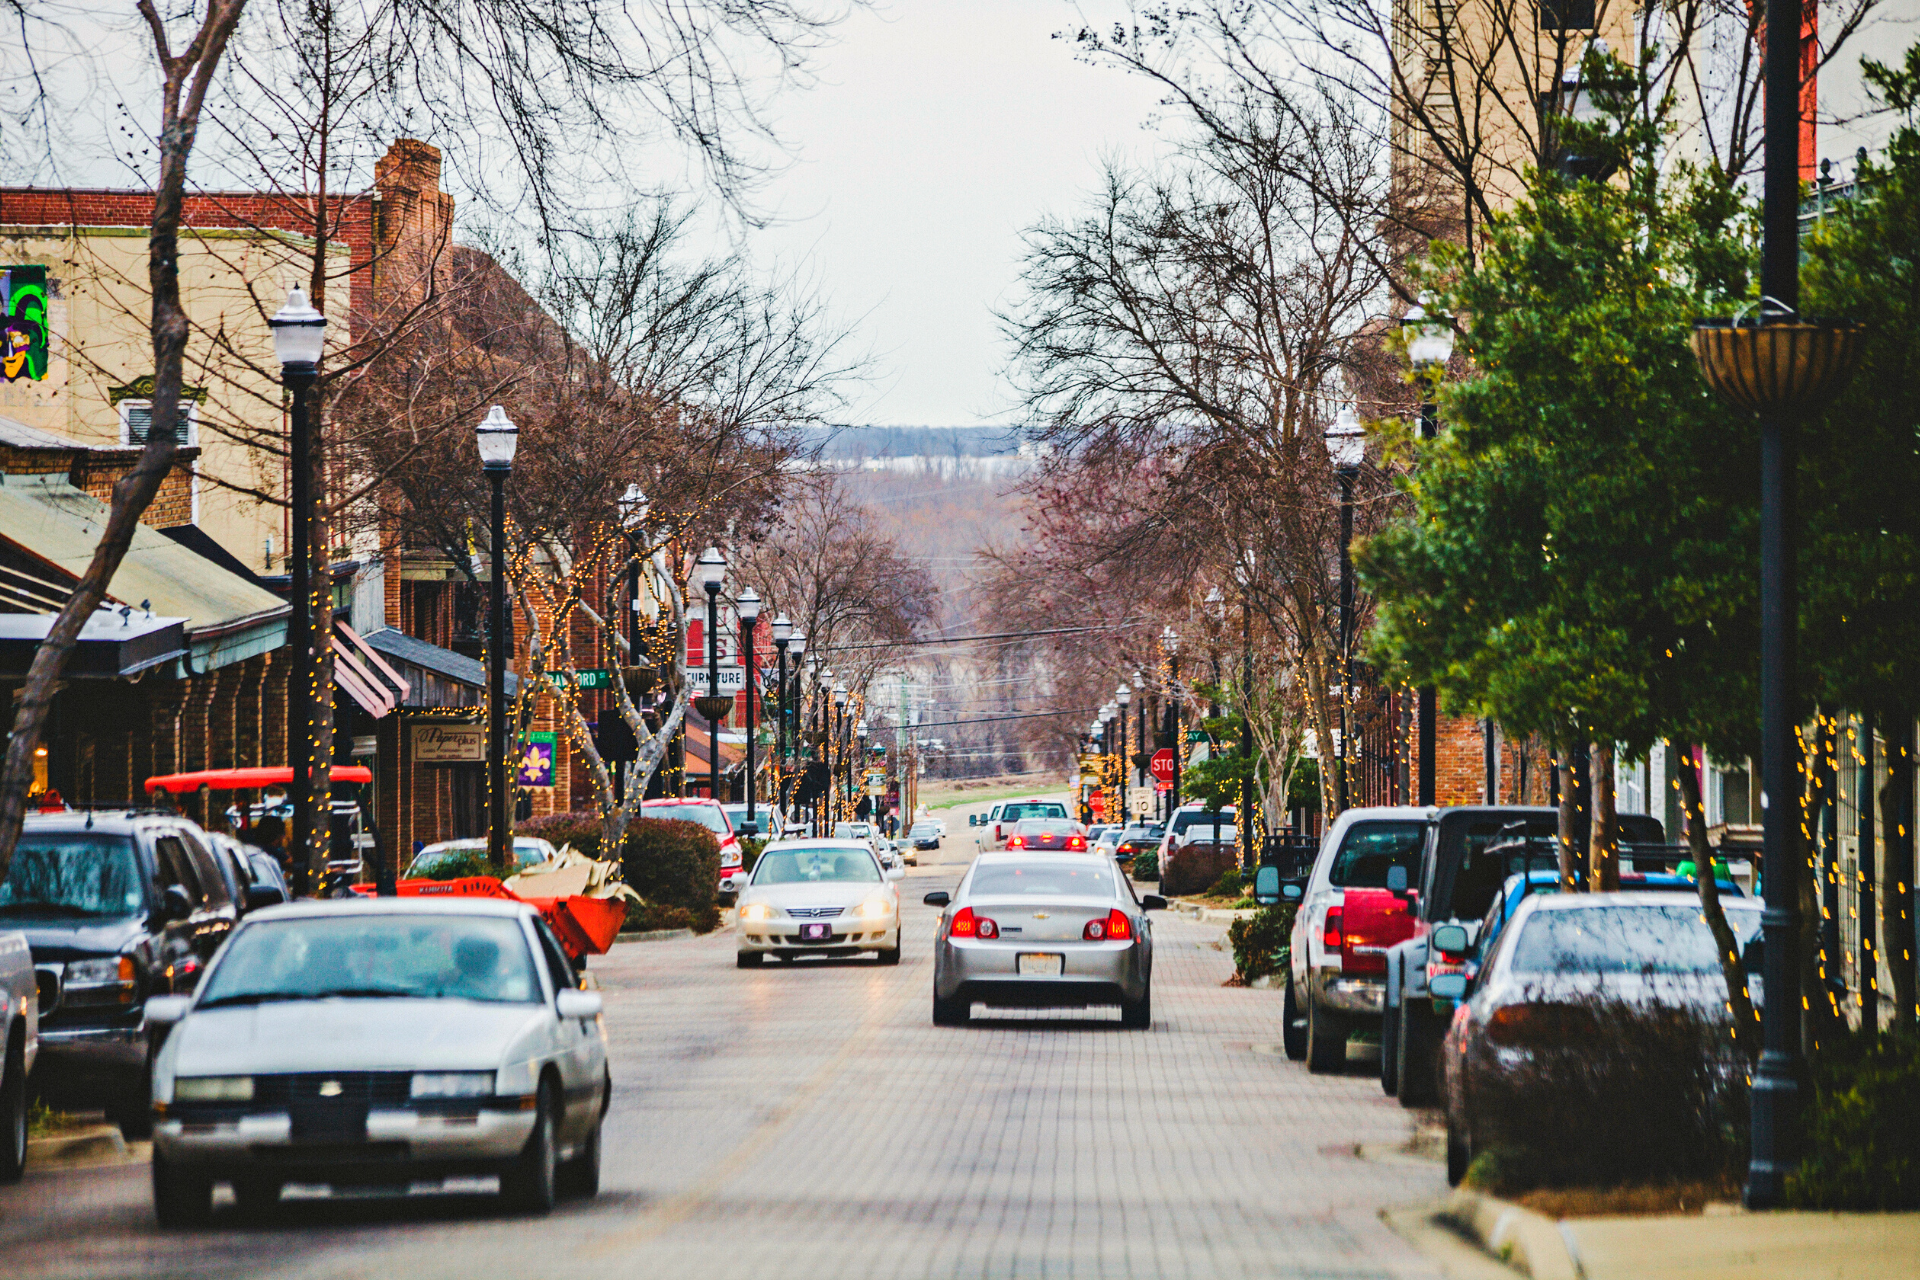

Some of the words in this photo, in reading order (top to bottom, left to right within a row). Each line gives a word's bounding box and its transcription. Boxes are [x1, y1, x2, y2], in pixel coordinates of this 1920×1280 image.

[686, 672, 741, 684] URNTURE
[1153, 758, 1174, 771] STO
[1136, 801, 1149, 812] 10
